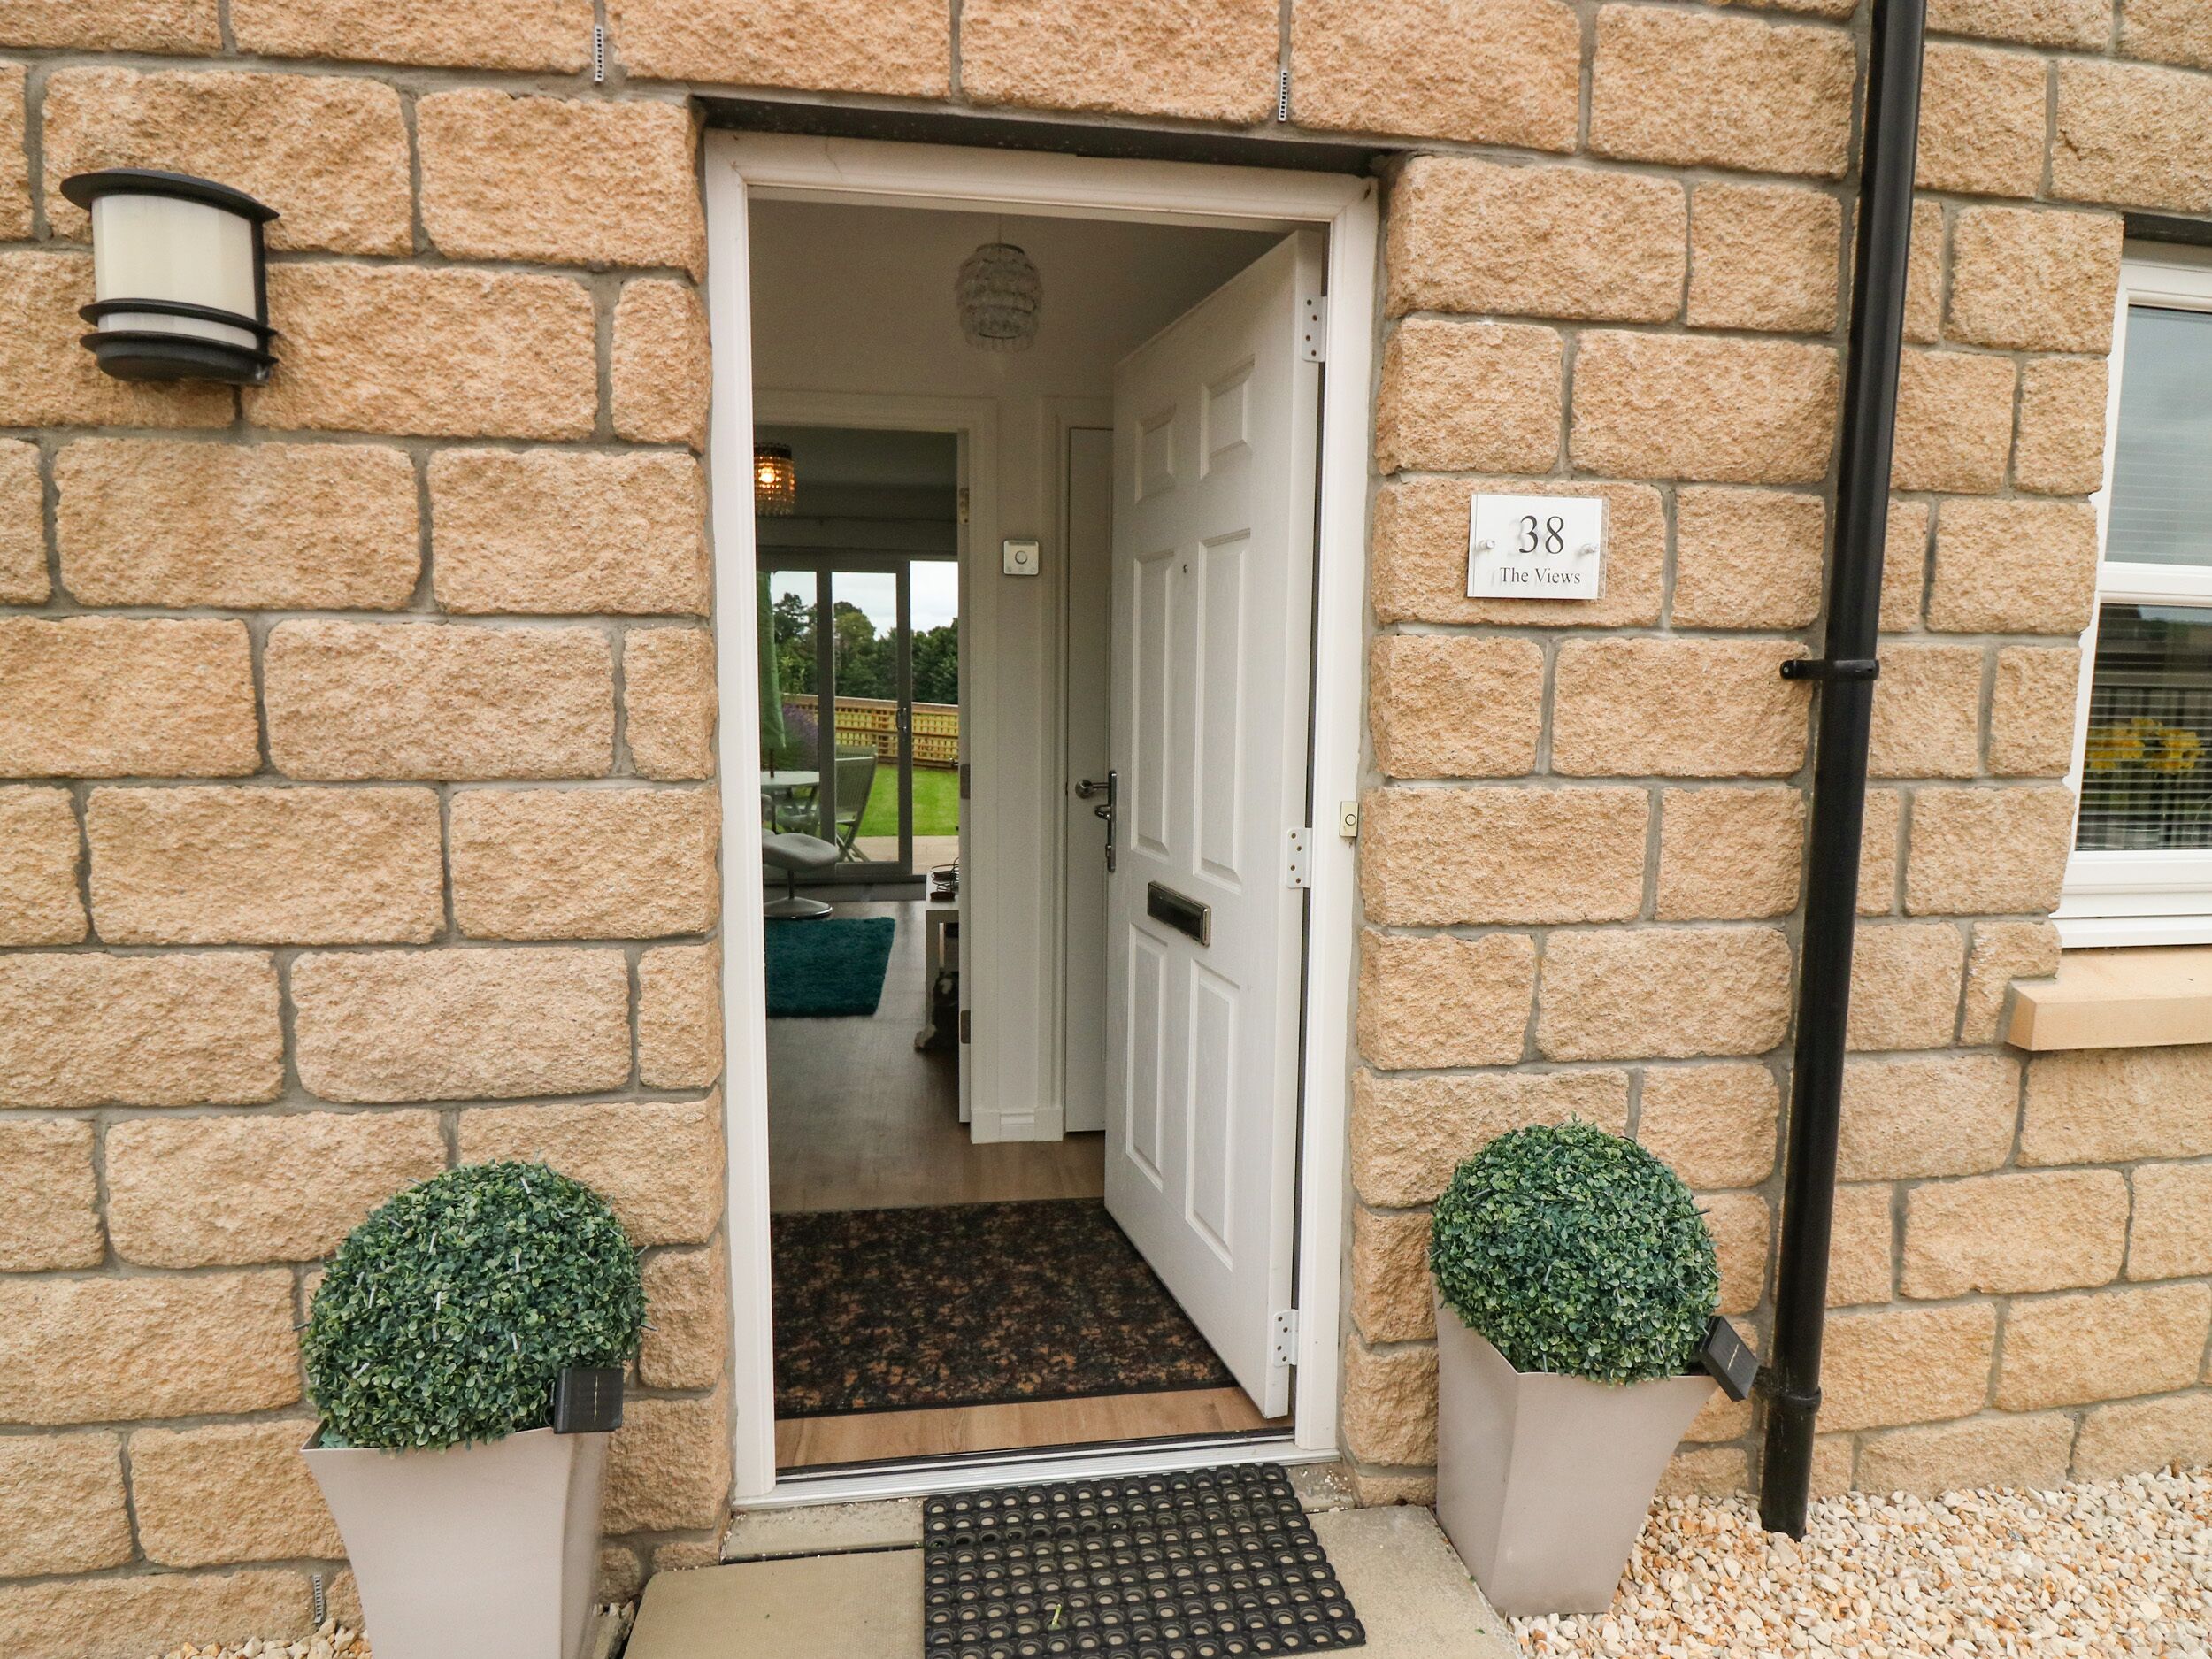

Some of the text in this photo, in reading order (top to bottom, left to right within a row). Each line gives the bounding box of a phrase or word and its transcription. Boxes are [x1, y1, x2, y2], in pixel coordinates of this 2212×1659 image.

[1518, 515, 1564, 555] 38
[1500, 567, 1581, 584] The Views
